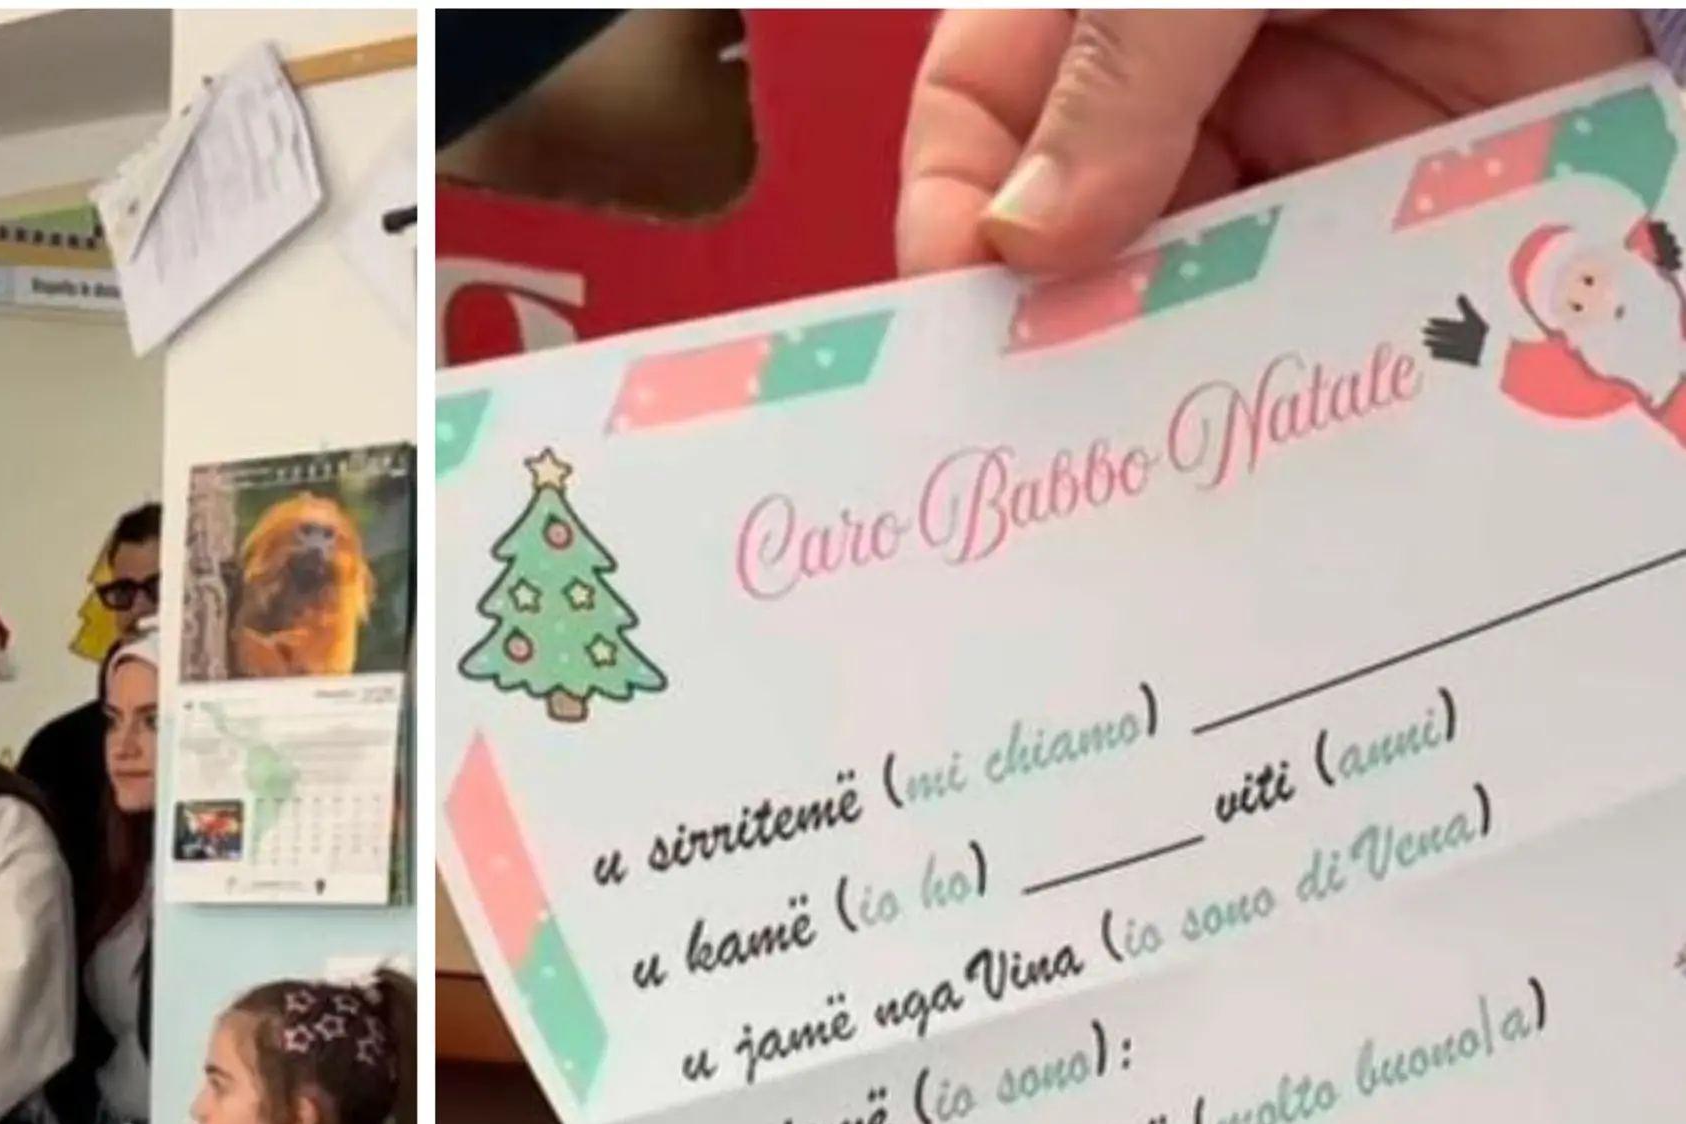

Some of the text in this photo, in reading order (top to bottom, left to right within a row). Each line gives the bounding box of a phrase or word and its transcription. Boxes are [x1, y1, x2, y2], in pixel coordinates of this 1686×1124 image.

[735, 340, 1426, 601] Caro Babbo Natale
[594, 682, 1158, 887] u sirritemë (mi chiamo)
[633, 686, 1456, 990] u kamë (io ho) viti (anni)
[681, 782, 1492, 1085] u jamë nga Vina (io sono di Vena)
[995, 1020, 1132, 1102] sono):
